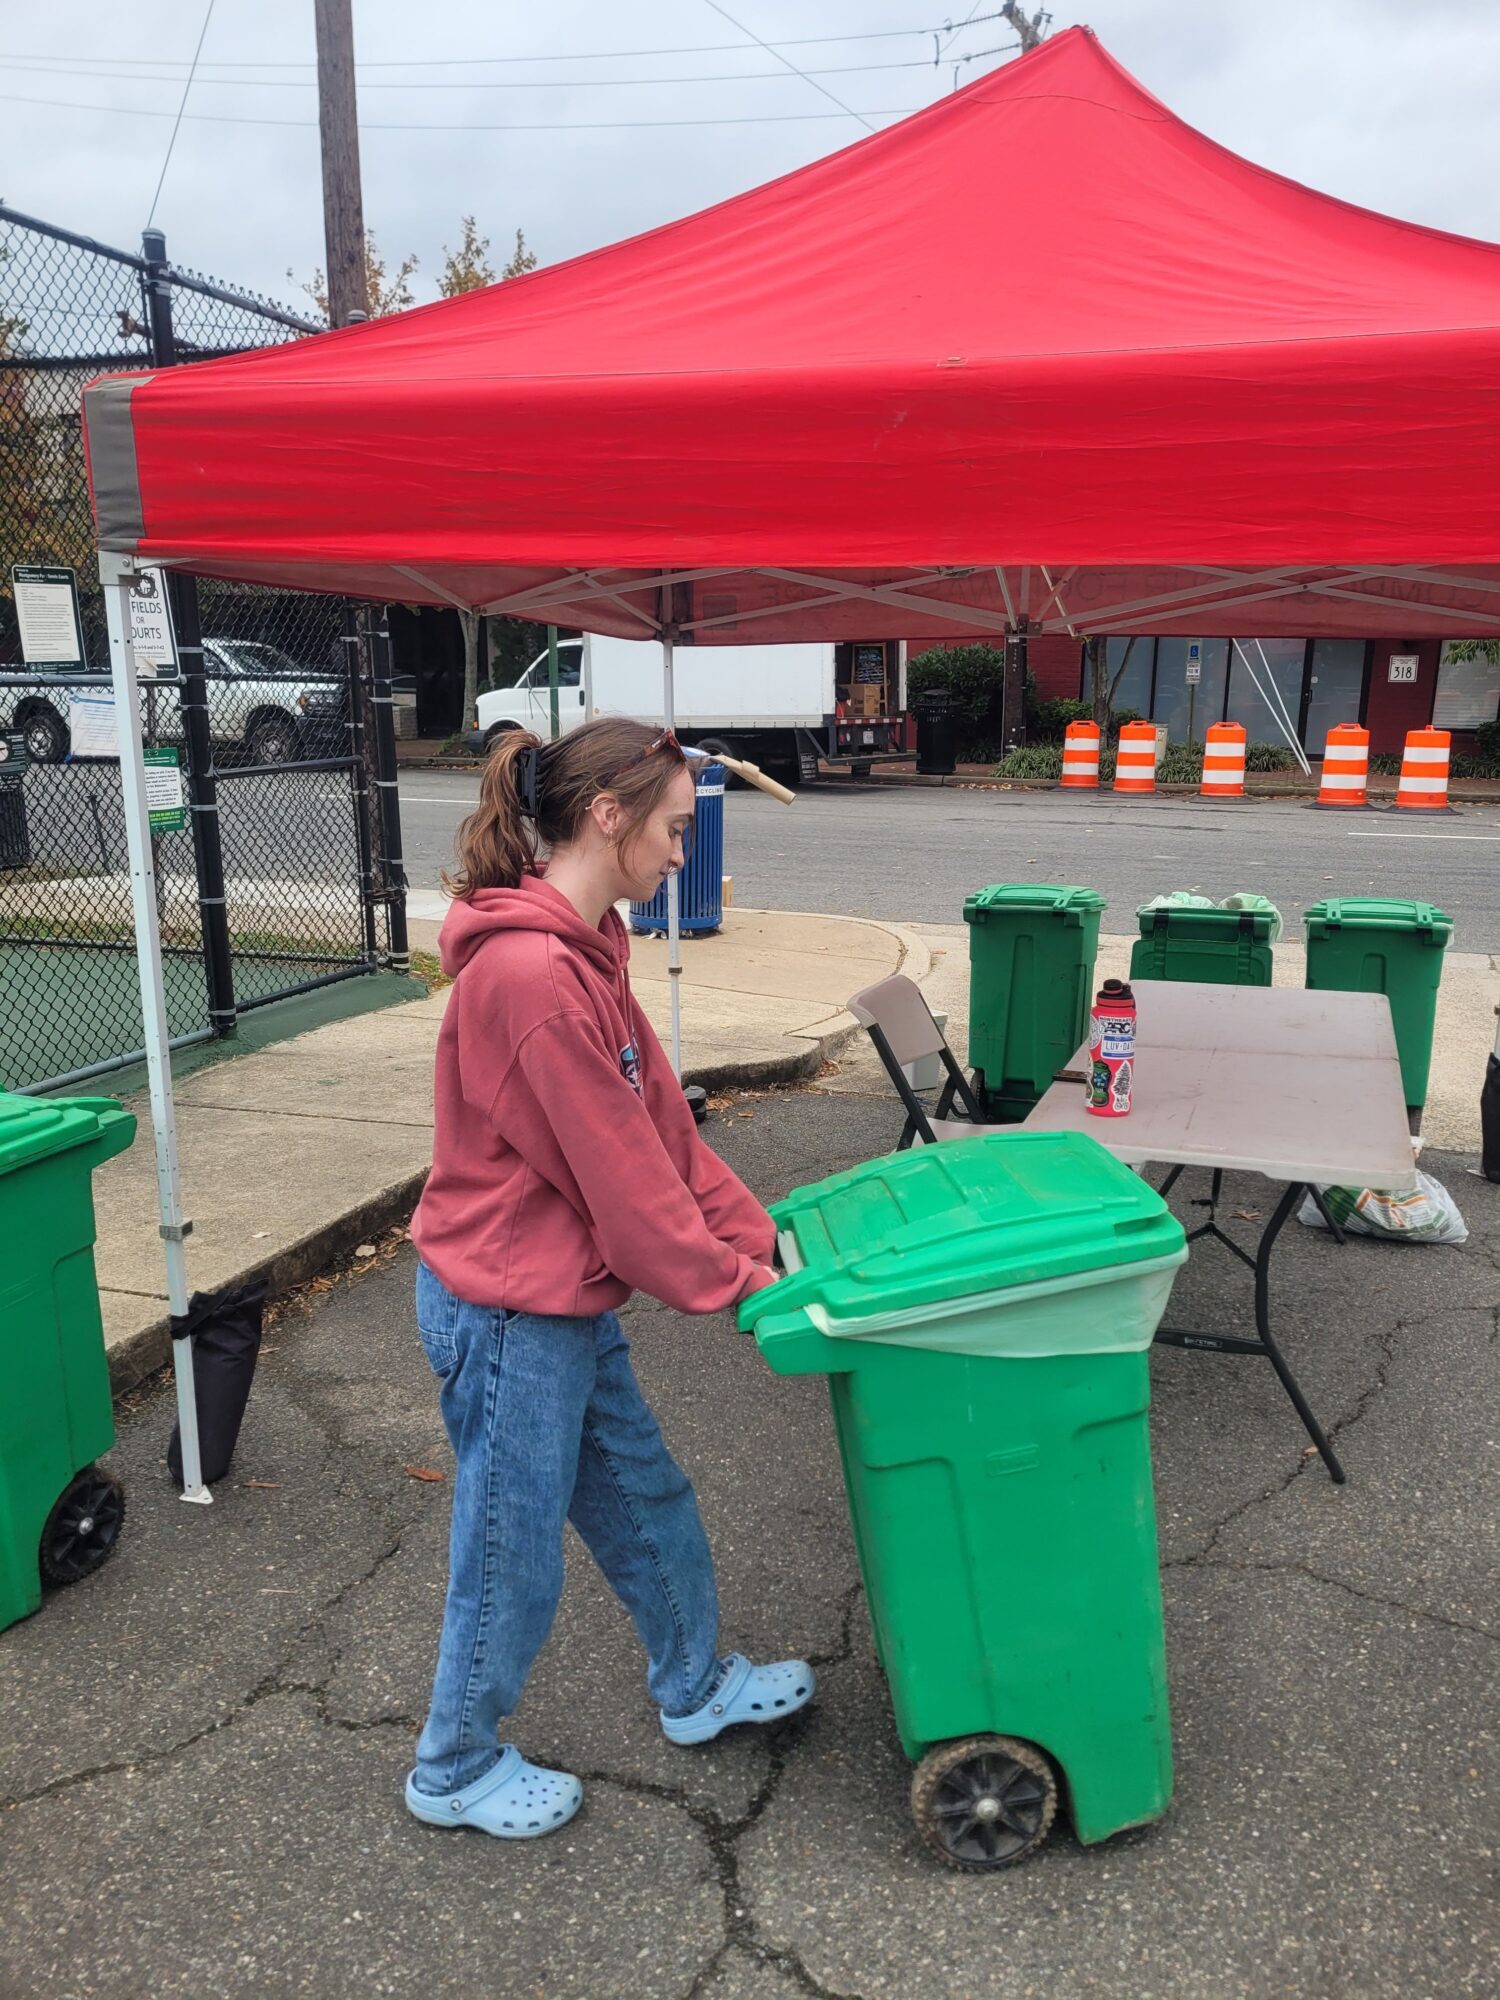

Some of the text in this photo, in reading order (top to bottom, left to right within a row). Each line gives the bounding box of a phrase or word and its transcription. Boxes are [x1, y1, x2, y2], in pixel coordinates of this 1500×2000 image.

[131, 601, 162, 614] FIELDS
[136, 616, 145, 624] OR
[131, 627, 162, 639] OURTS
[1393, 666, 1412, 679] 318
[696, 787, 723, 795] ECYCLING
